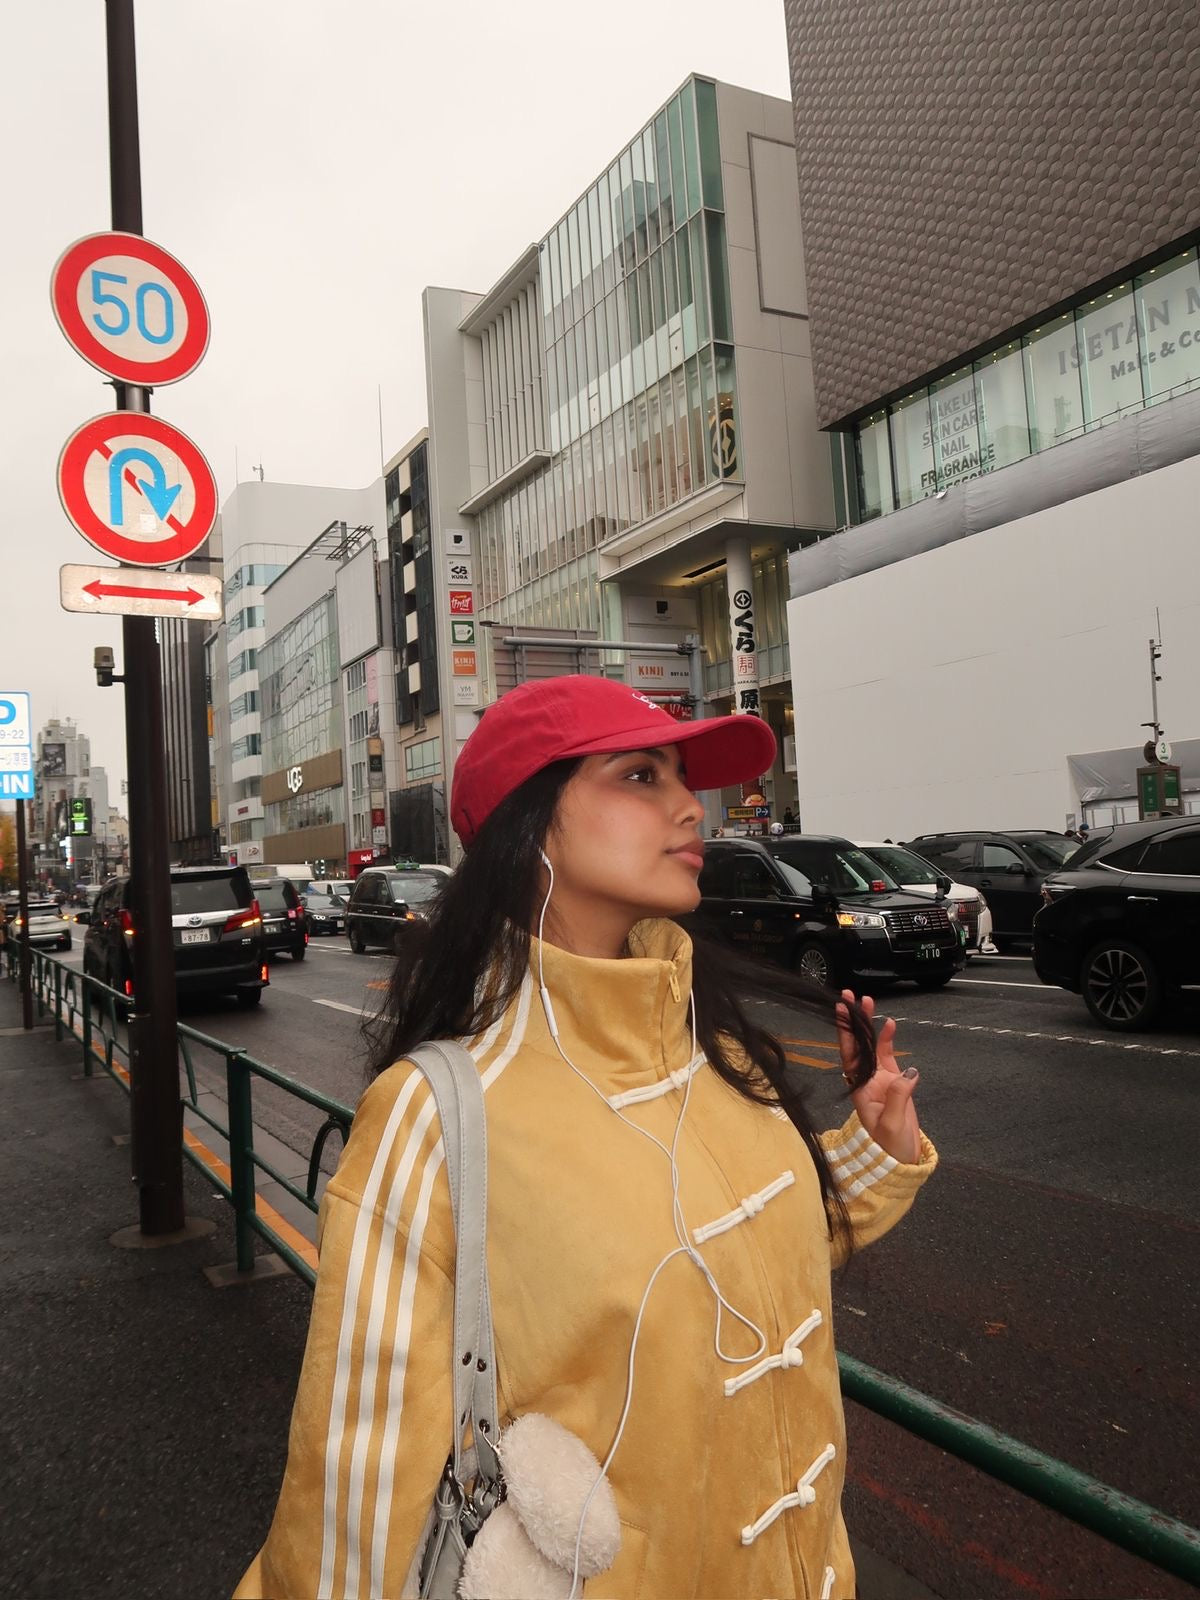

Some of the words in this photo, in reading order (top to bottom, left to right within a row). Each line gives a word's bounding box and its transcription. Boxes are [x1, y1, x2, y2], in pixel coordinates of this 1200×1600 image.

[91, 270, 174, 345] 50
[1058, 299, 1170, 375] ISETAN
[1160, 341, 1176, 358] &
[920, 443, 996, 488] FRAGRANCE
[941, 435, 970, 458] NAIL
[735, 609, 756, 654] くら
[287, 766, 303, 793] UGG
